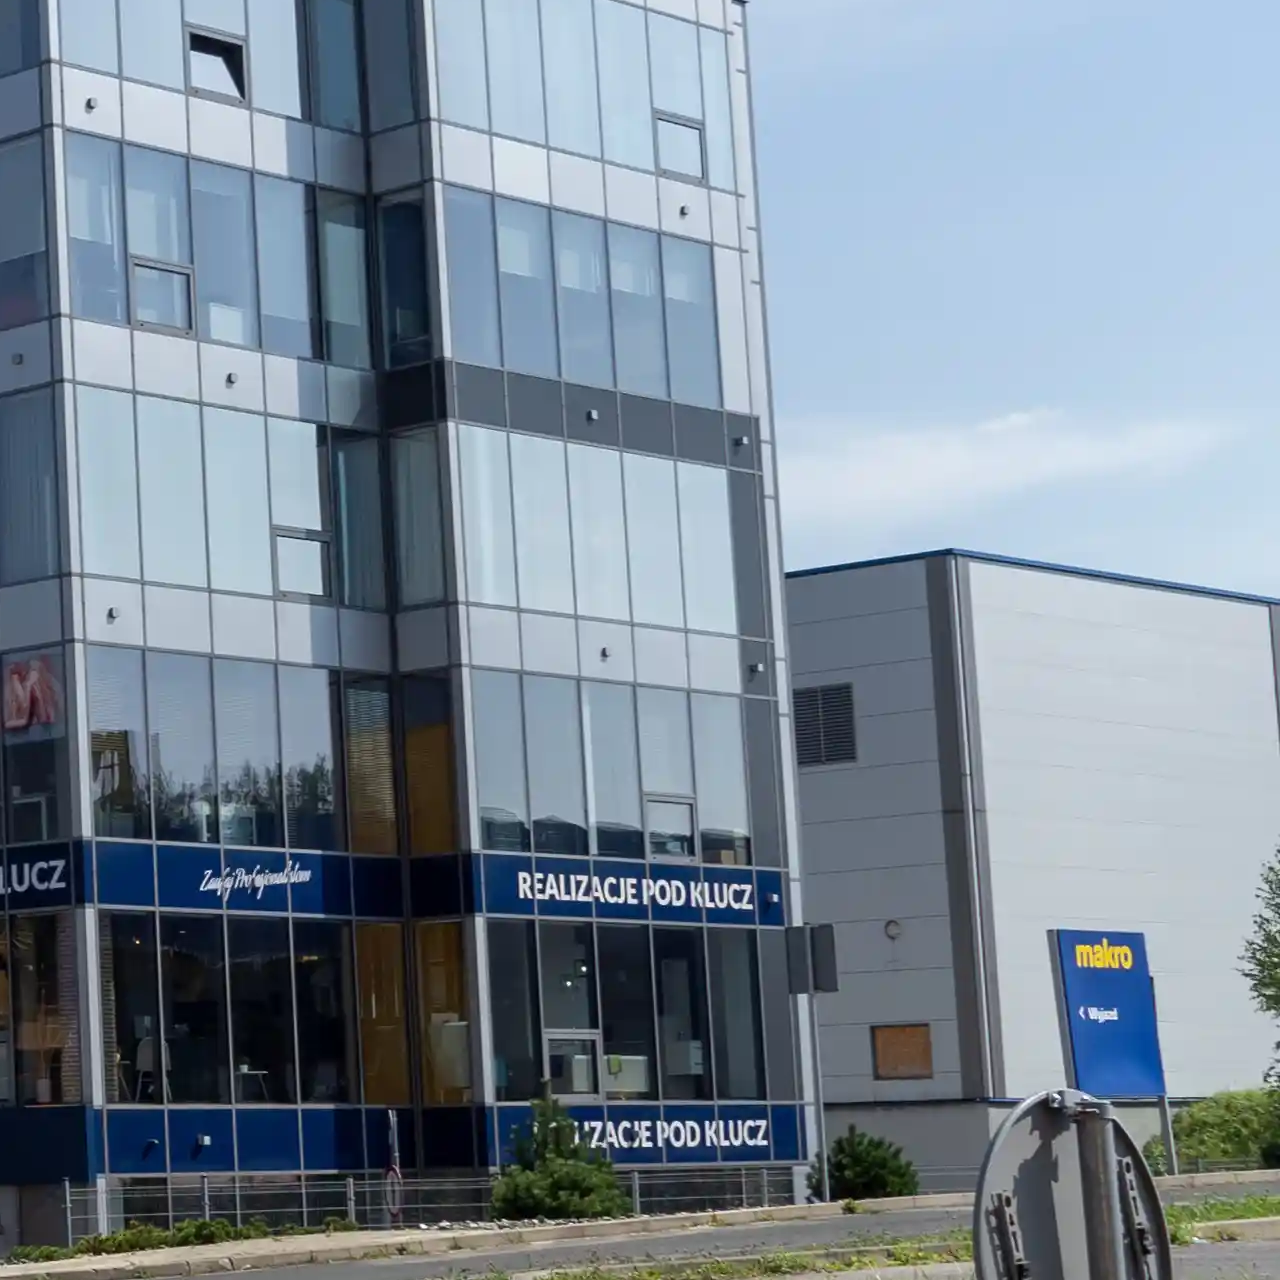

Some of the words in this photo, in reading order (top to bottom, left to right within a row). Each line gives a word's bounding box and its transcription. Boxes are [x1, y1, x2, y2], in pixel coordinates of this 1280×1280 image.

[518, 871, 639, 905] REALIZACJE
[643, 879, 686, 907] POD
[690, 881, 754, 910] KLUCZ
[1075, 937, 1134, 970] makro
[657, 1120, 701, 1148] POD
[704, 1119, 769, 1147] KLUCZ
